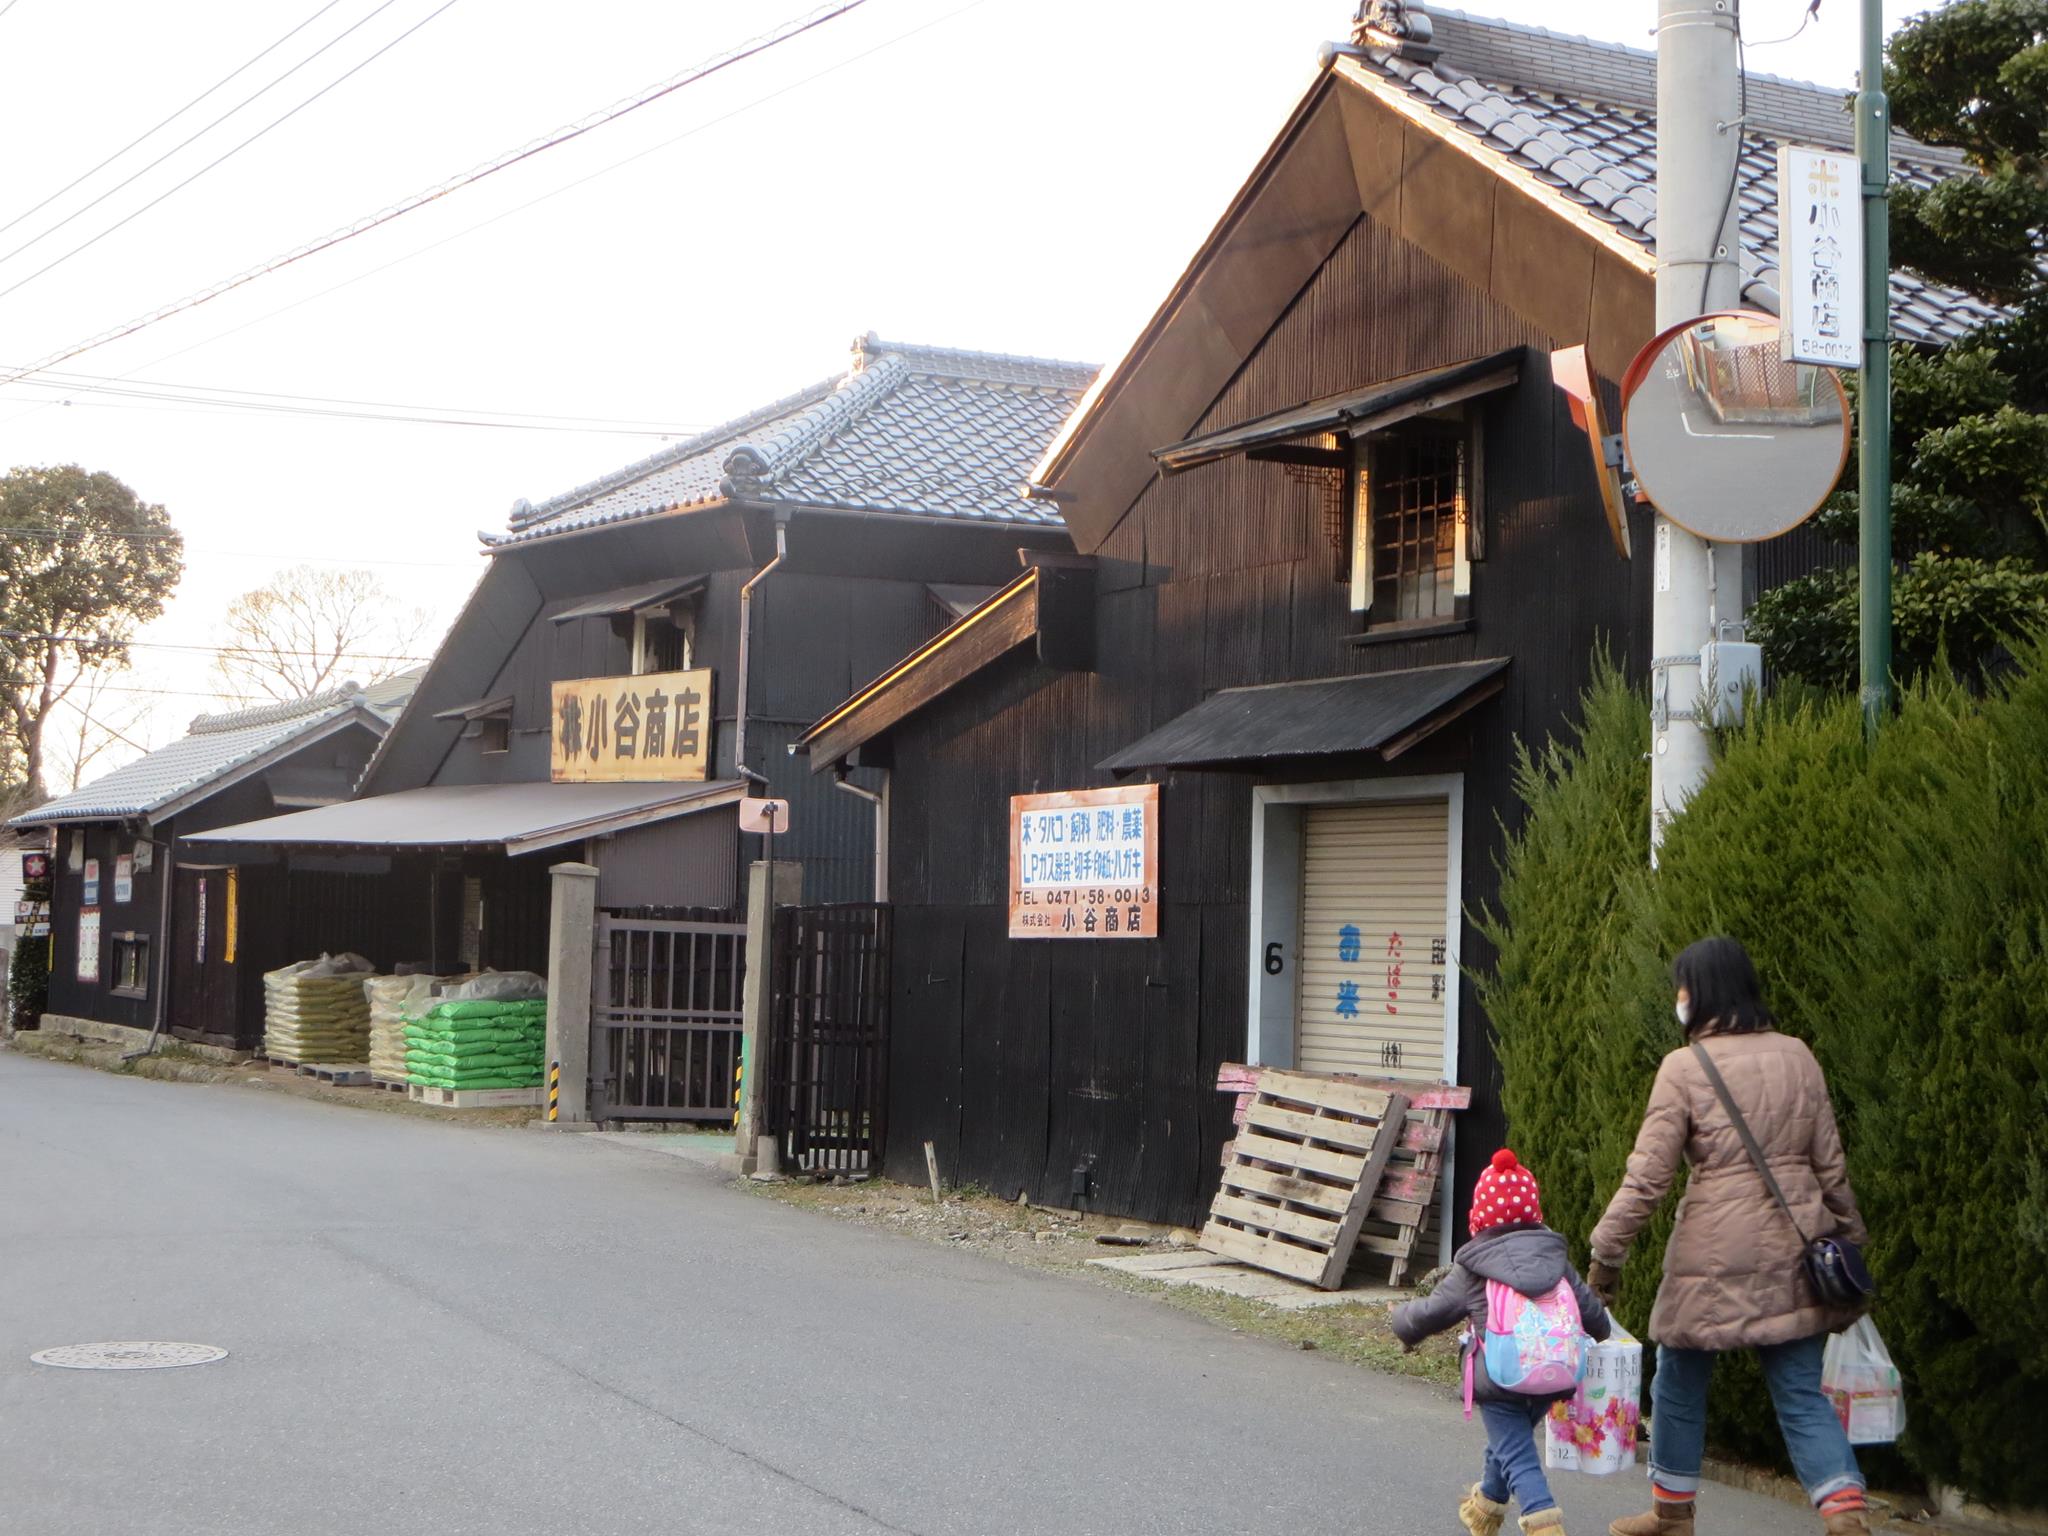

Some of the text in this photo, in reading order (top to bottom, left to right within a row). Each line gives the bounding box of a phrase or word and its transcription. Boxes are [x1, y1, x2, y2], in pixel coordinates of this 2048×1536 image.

[1015, 890, 1038, 905] TEL
[1022, 904, 1141, 933] 株式会社 小谷商店
[1265, 942, 1283, 975] 6
[1386, 931, 1405, 1016] たばこ
